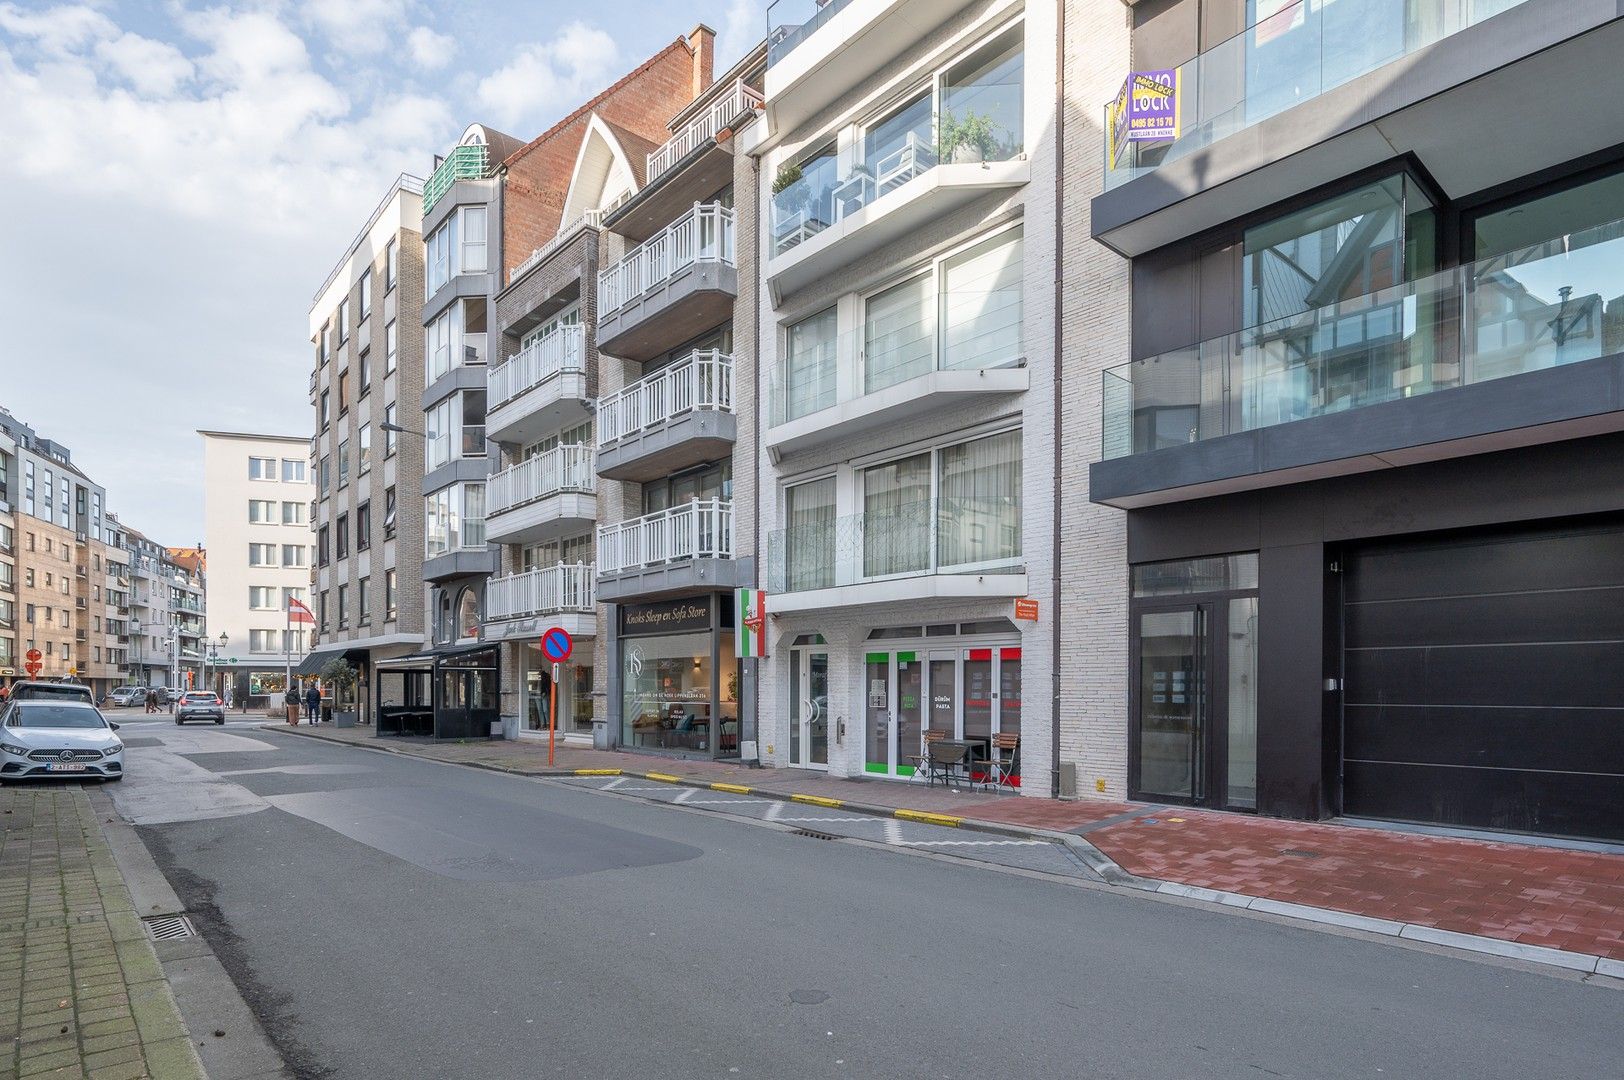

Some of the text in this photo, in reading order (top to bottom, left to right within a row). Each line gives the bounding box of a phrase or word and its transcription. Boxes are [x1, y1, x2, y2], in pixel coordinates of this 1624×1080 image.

[1135, 76, 1173, 96] IMMO LOCK
[1133, 95, 1170, 112] LOCK
[1156, 117, 1164, 127] 15
[645, 609, 662, 625] Sleep
[662, 612, 671, 621] en
[671, 605, 687, 623] Sofa
[687, 606, 706, 618] Store
